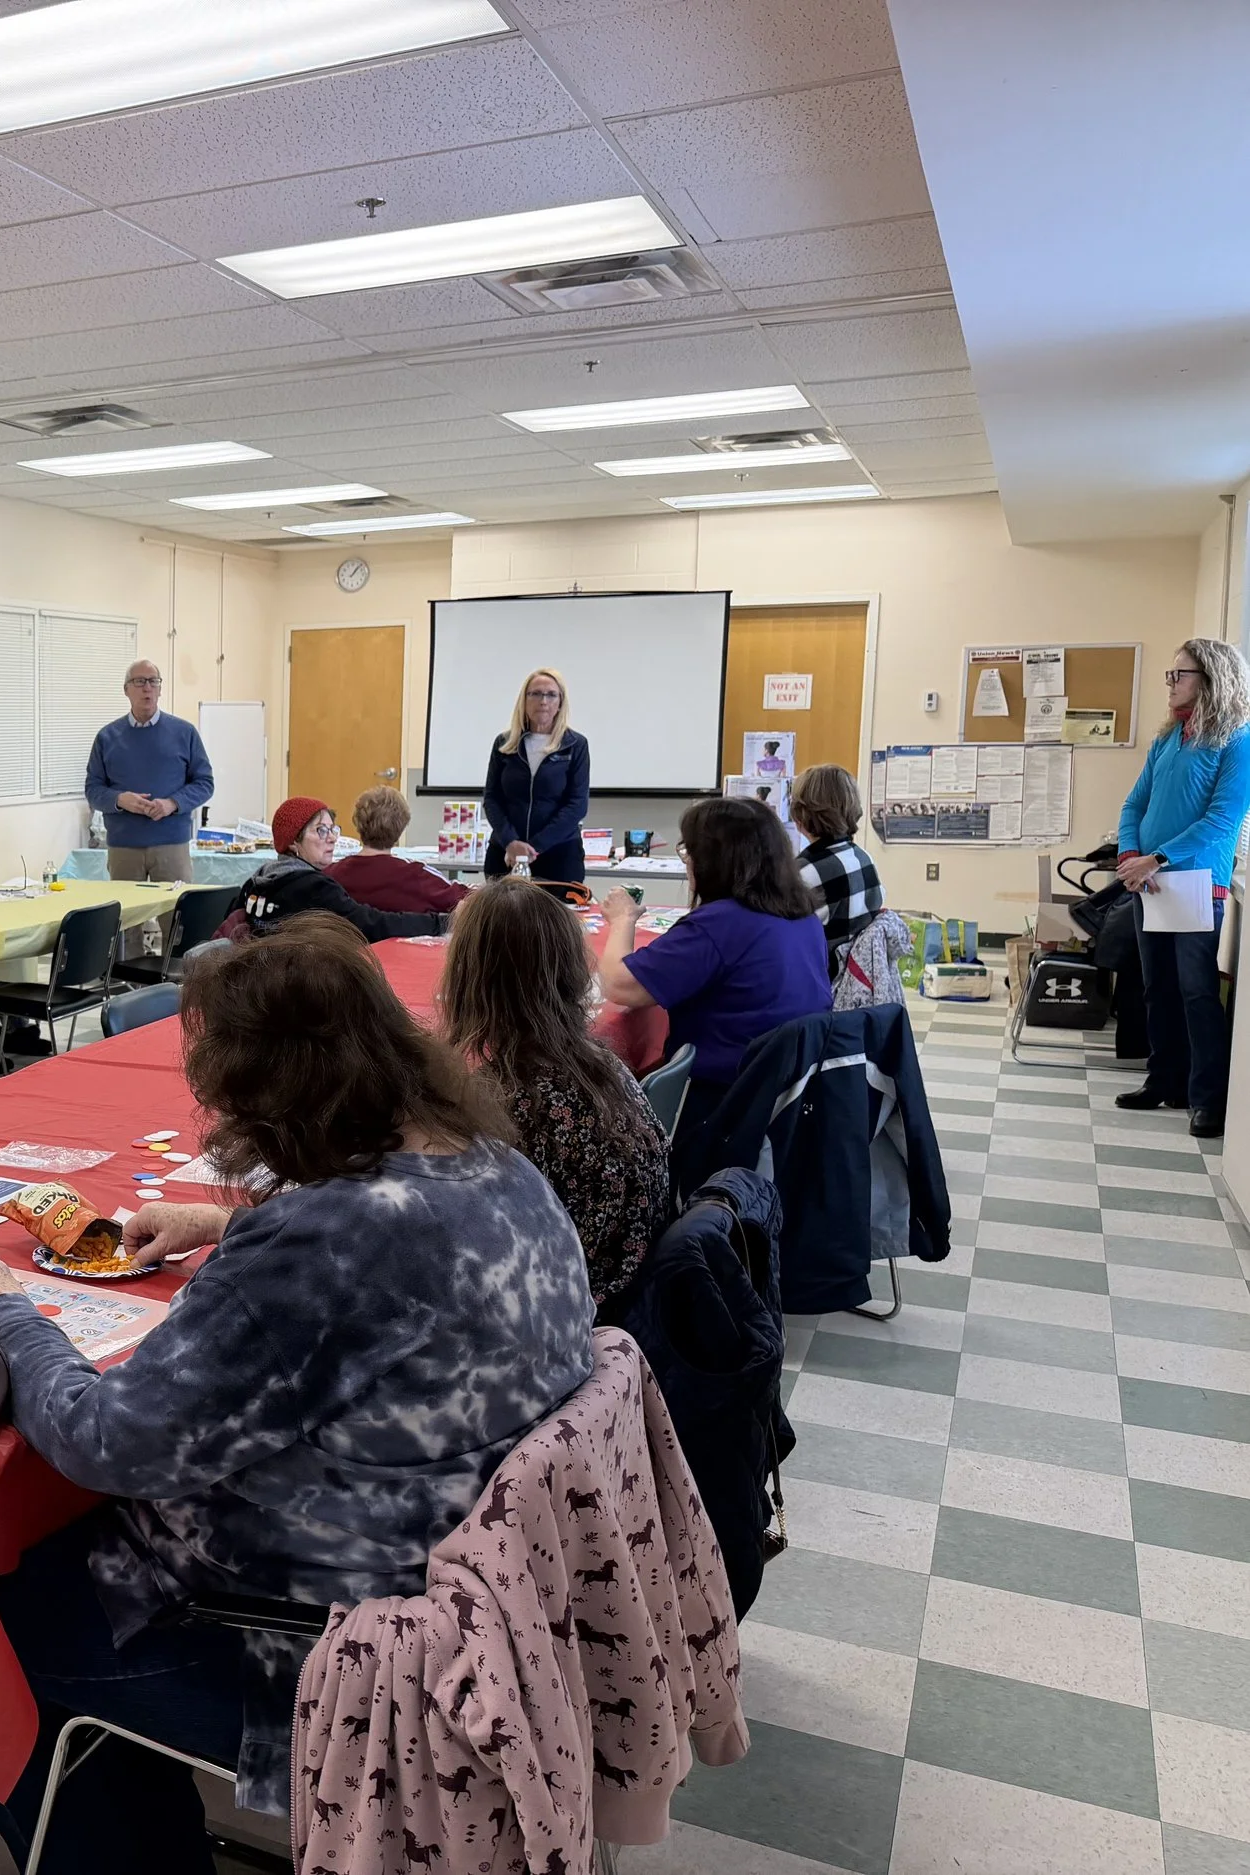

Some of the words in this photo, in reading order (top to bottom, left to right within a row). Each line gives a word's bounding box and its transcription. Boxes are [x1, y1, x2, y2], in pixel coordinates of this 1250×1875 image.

[770, 682, 789, 690] NOT
[792, 682, 806, 690] AN
[776, 694, 798, 702] EXIT
